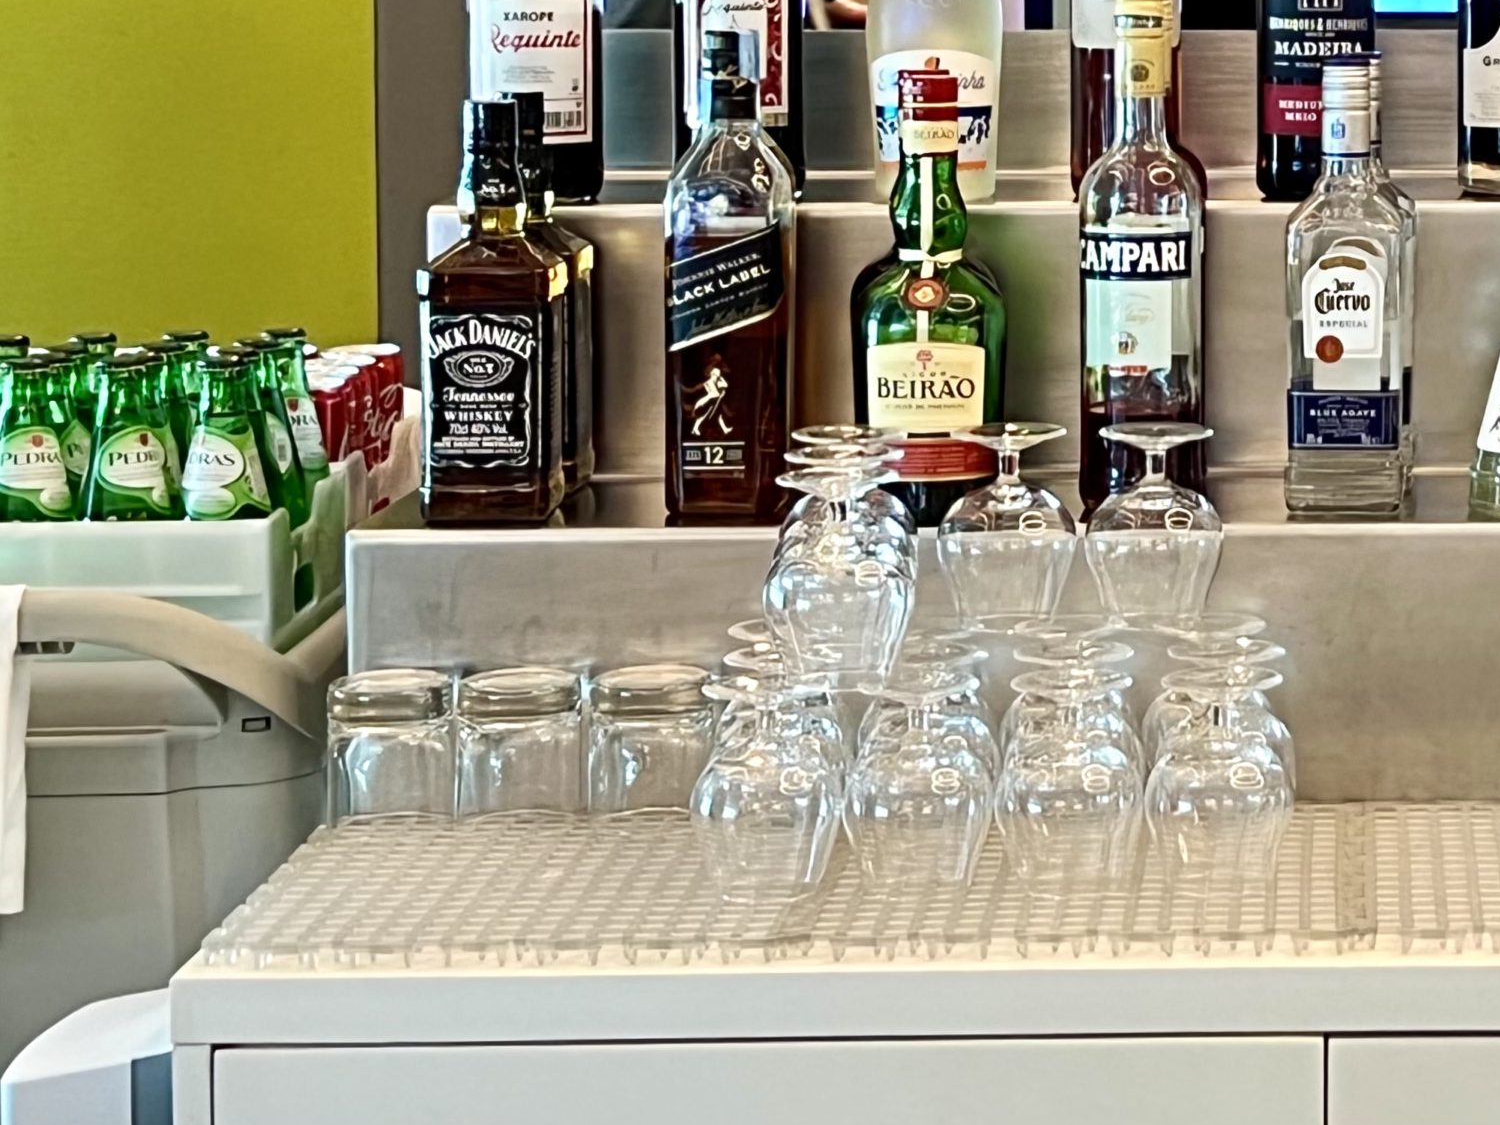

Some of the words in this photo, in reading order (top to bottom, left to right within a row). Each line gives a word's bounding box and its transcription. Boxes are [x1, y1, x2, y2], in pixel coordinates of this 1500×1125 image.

[503, 11, 554, 22] XAROPE
[1274, 40, 1363, 57] MADEIRA
[718, 263, 772, 289] LABEL
[1314, 287, 1371, 315] Cuervo
[428, 326, 468, 359] JACK
[468, 319, 536, 360] DANIEL'S
[442, 386, 515, 403] Tennessee
[877, 375, 976, 399] BEIRÃO
[443, 410, 514, 422] WHISKEY
[0, 451, 62, 467] PEDRA
[189, 451, 235, 467] DRAS
[704, 446, 725, 464] 12
